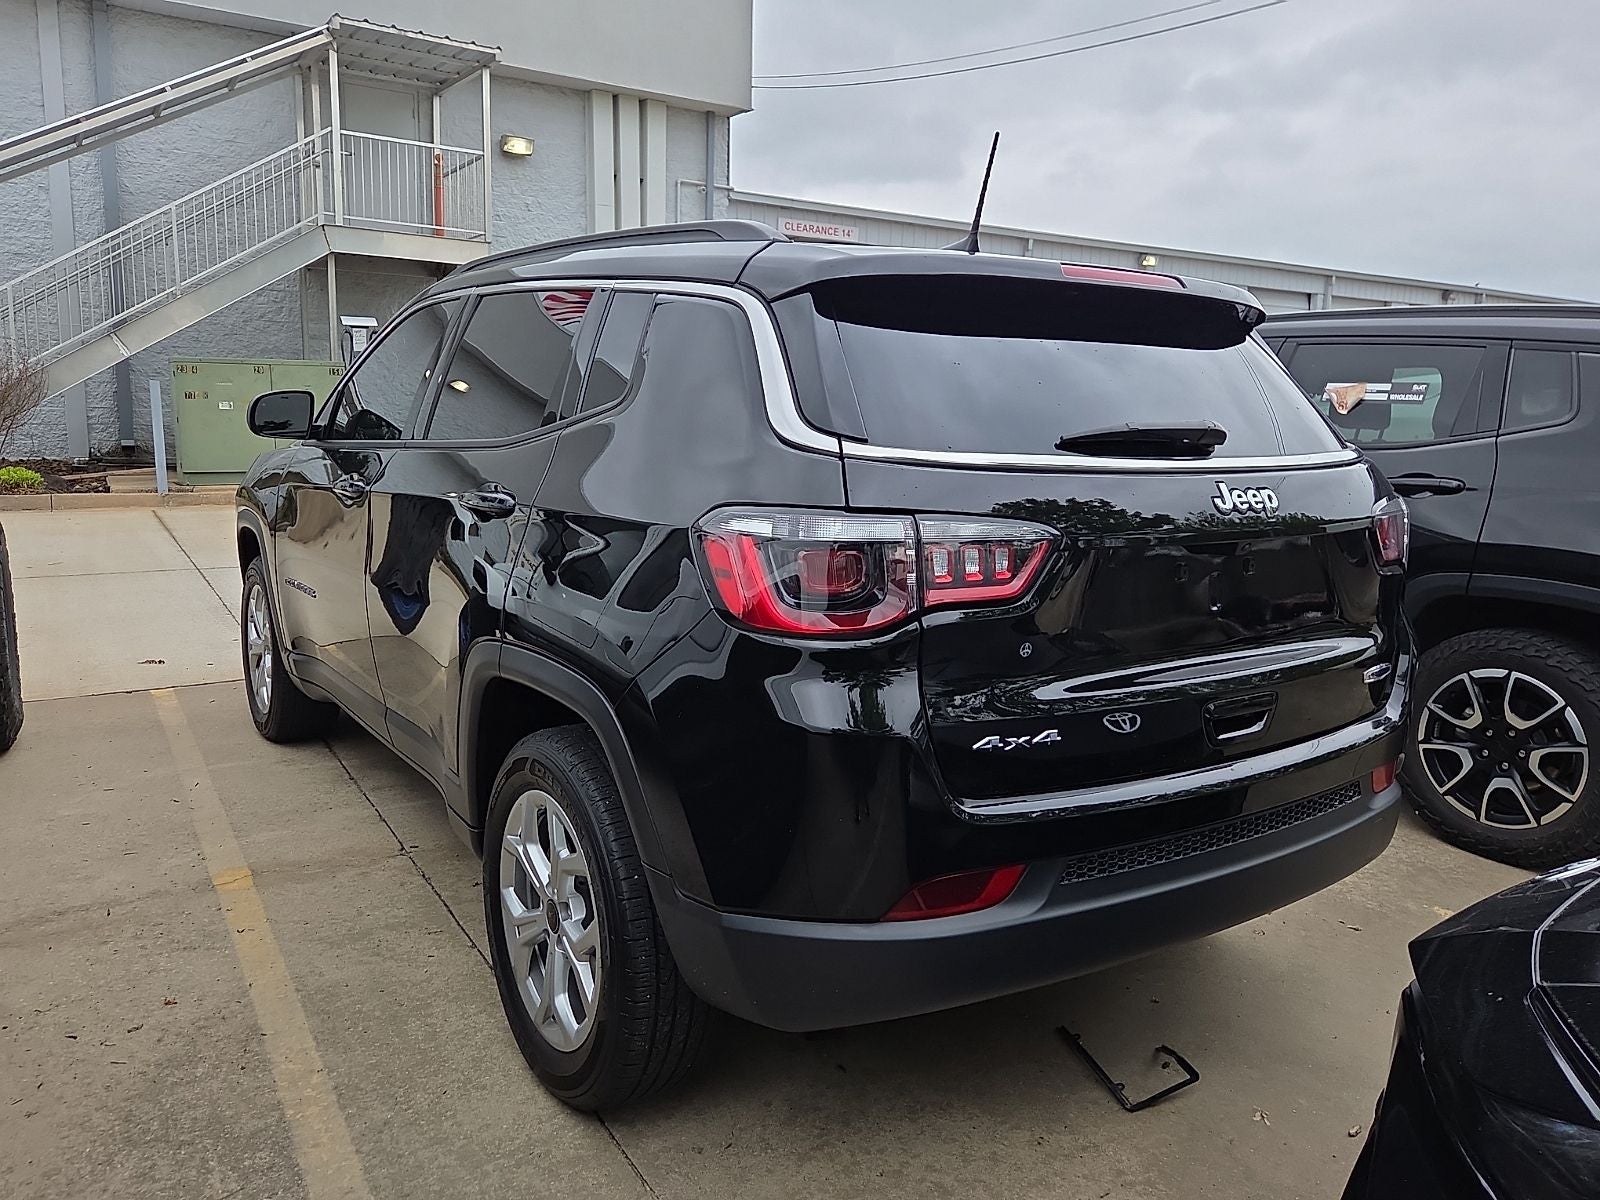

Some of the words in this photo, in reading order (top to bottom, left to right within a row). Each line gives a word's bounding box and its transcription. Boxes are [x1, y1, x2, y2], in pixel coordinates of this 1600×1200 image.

[784, 221, 840, 237] CLEARANCE
[1389, 393, 1424, 401] WHOLESALE
[1211, 480, 1280, 520] Jeep
